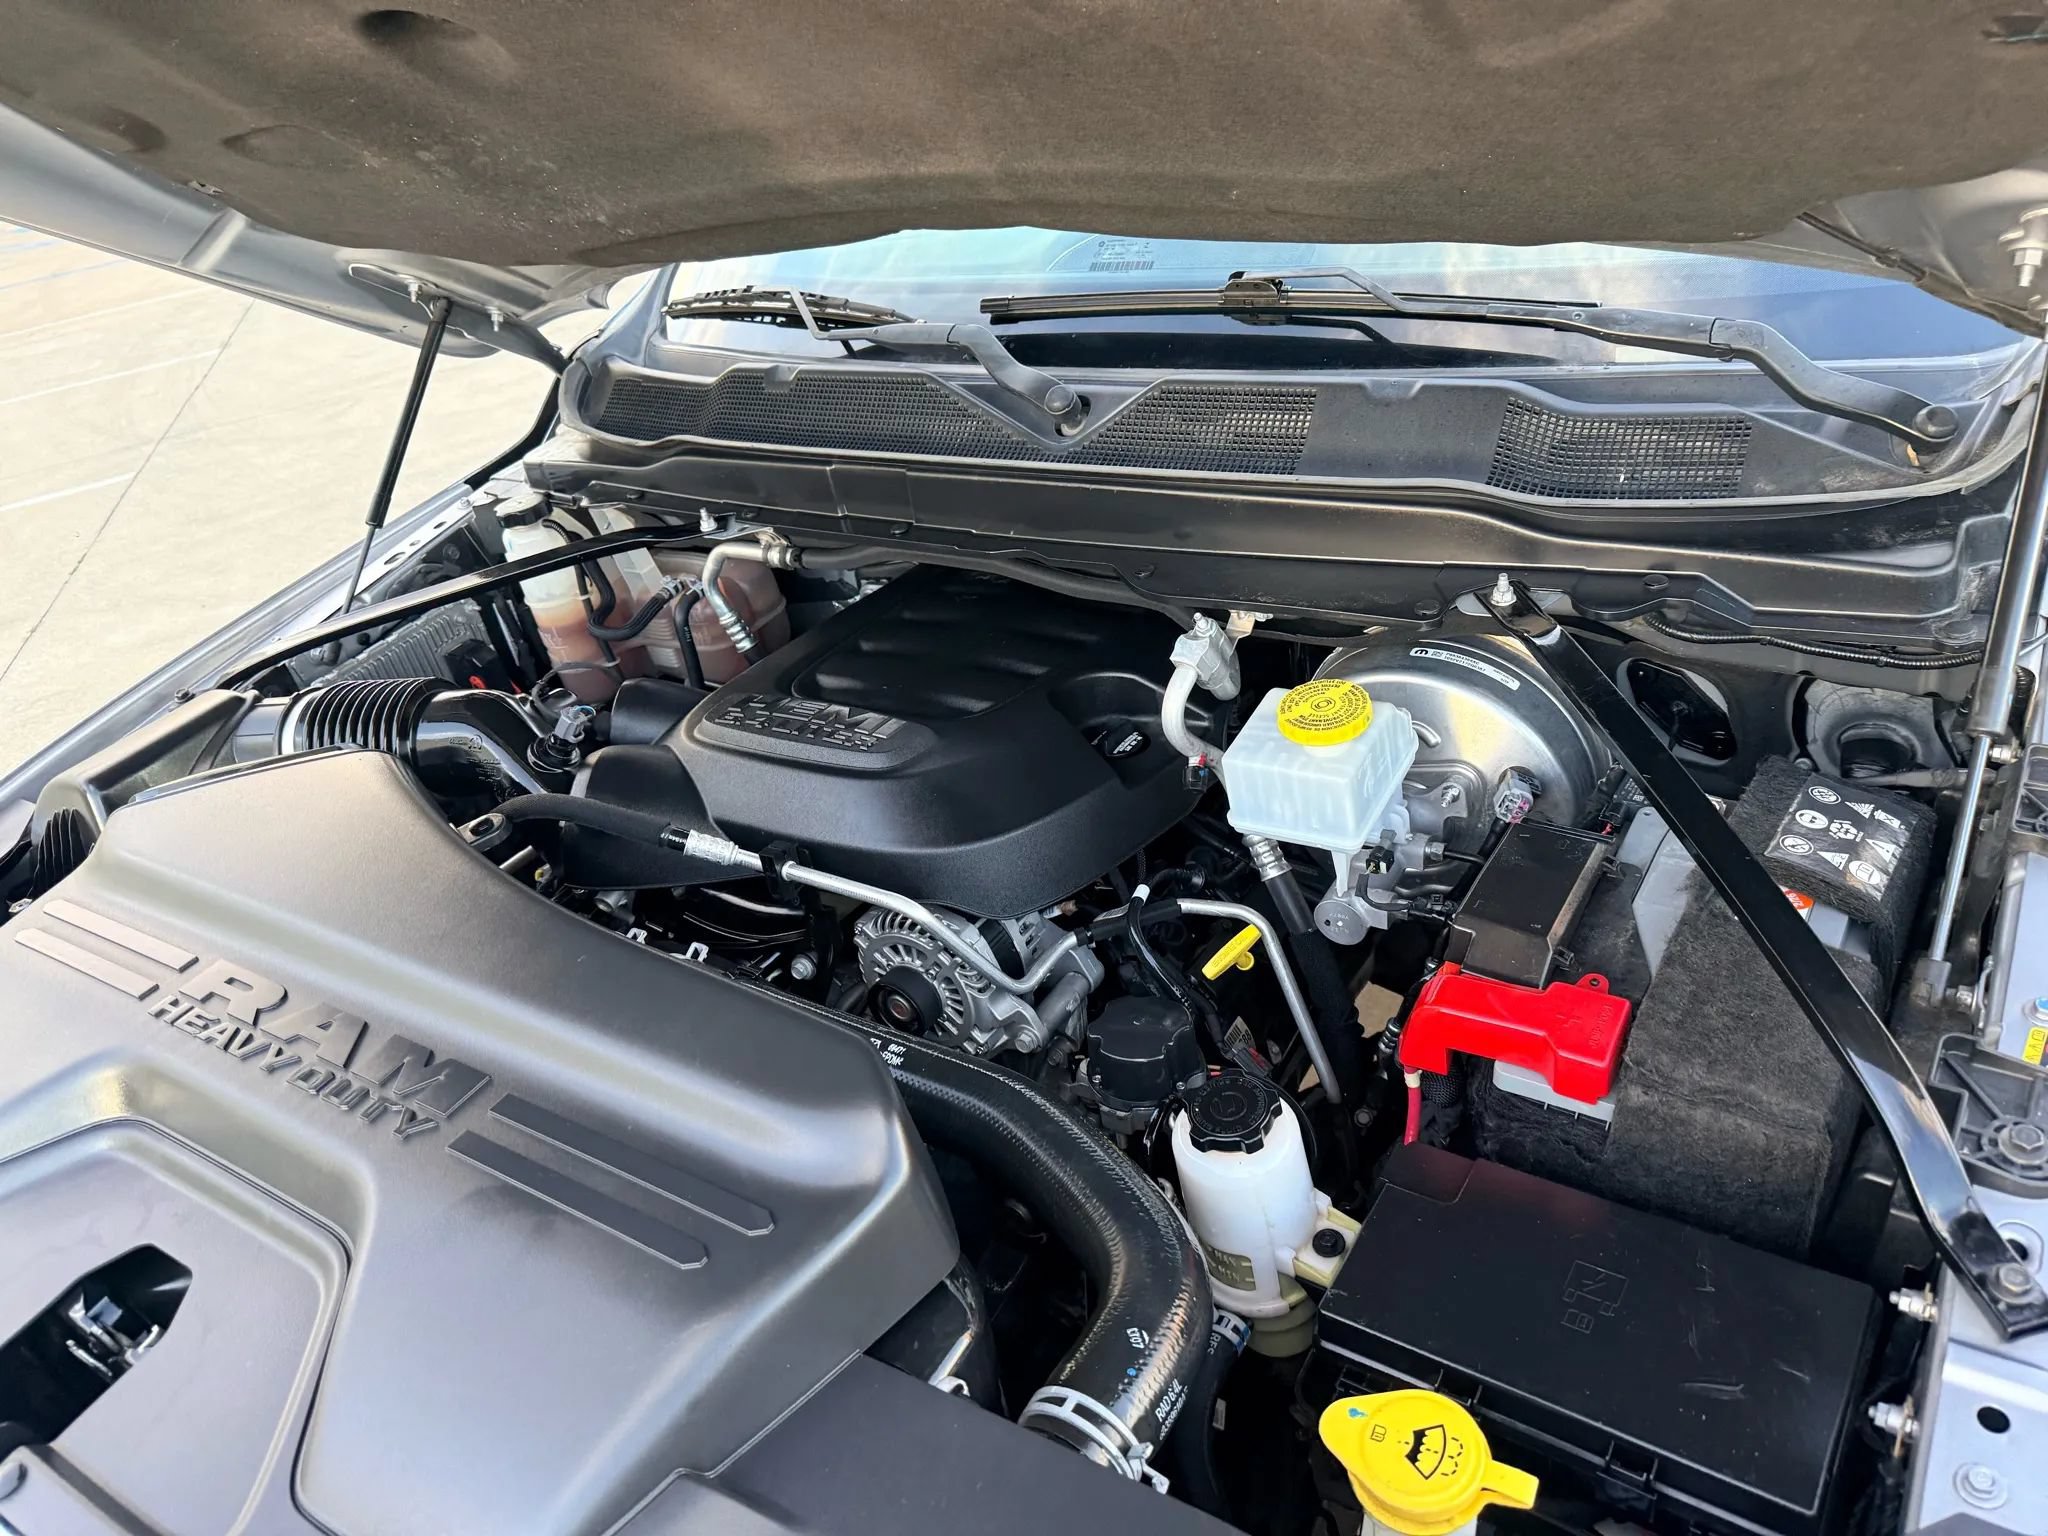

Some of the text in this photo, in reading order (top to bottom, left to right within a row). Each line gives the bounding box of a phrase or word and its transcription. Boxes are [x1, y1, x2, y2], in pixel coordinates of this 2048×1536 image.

[727, 694, 907, 739] HEMI
[147, 995, 439, 1140] HEAVY DUTY
[178, 959, 491, 1118] RAM
[1155, 1396, 1171, 1422] RAD
